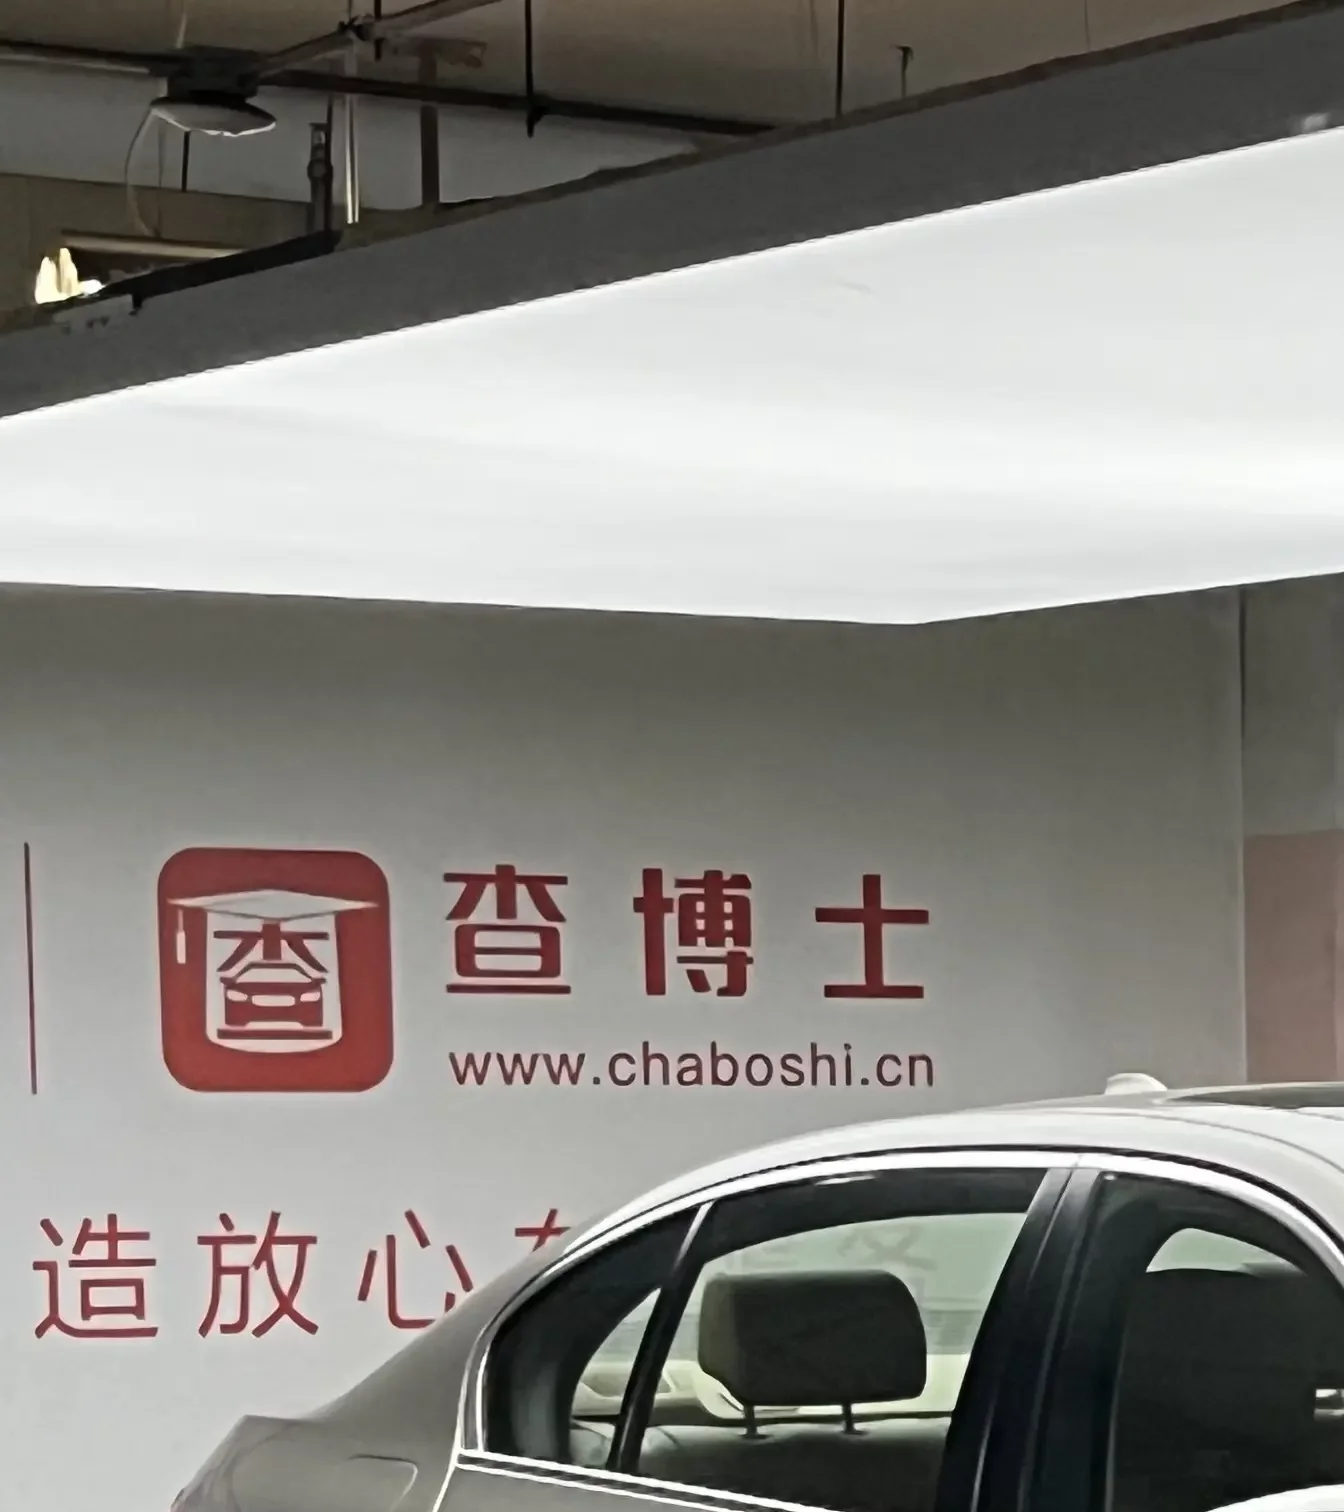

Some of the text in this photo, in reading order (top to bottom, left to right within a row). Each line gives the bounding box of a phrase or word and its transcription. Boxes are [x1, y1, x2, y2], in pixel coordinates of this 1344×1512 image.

[442, 863, 932, 999] 查博士
[448, 1041, 936, 1089] www.chaboshi.cn
[32, 1207, 569, 1341] 造放心
